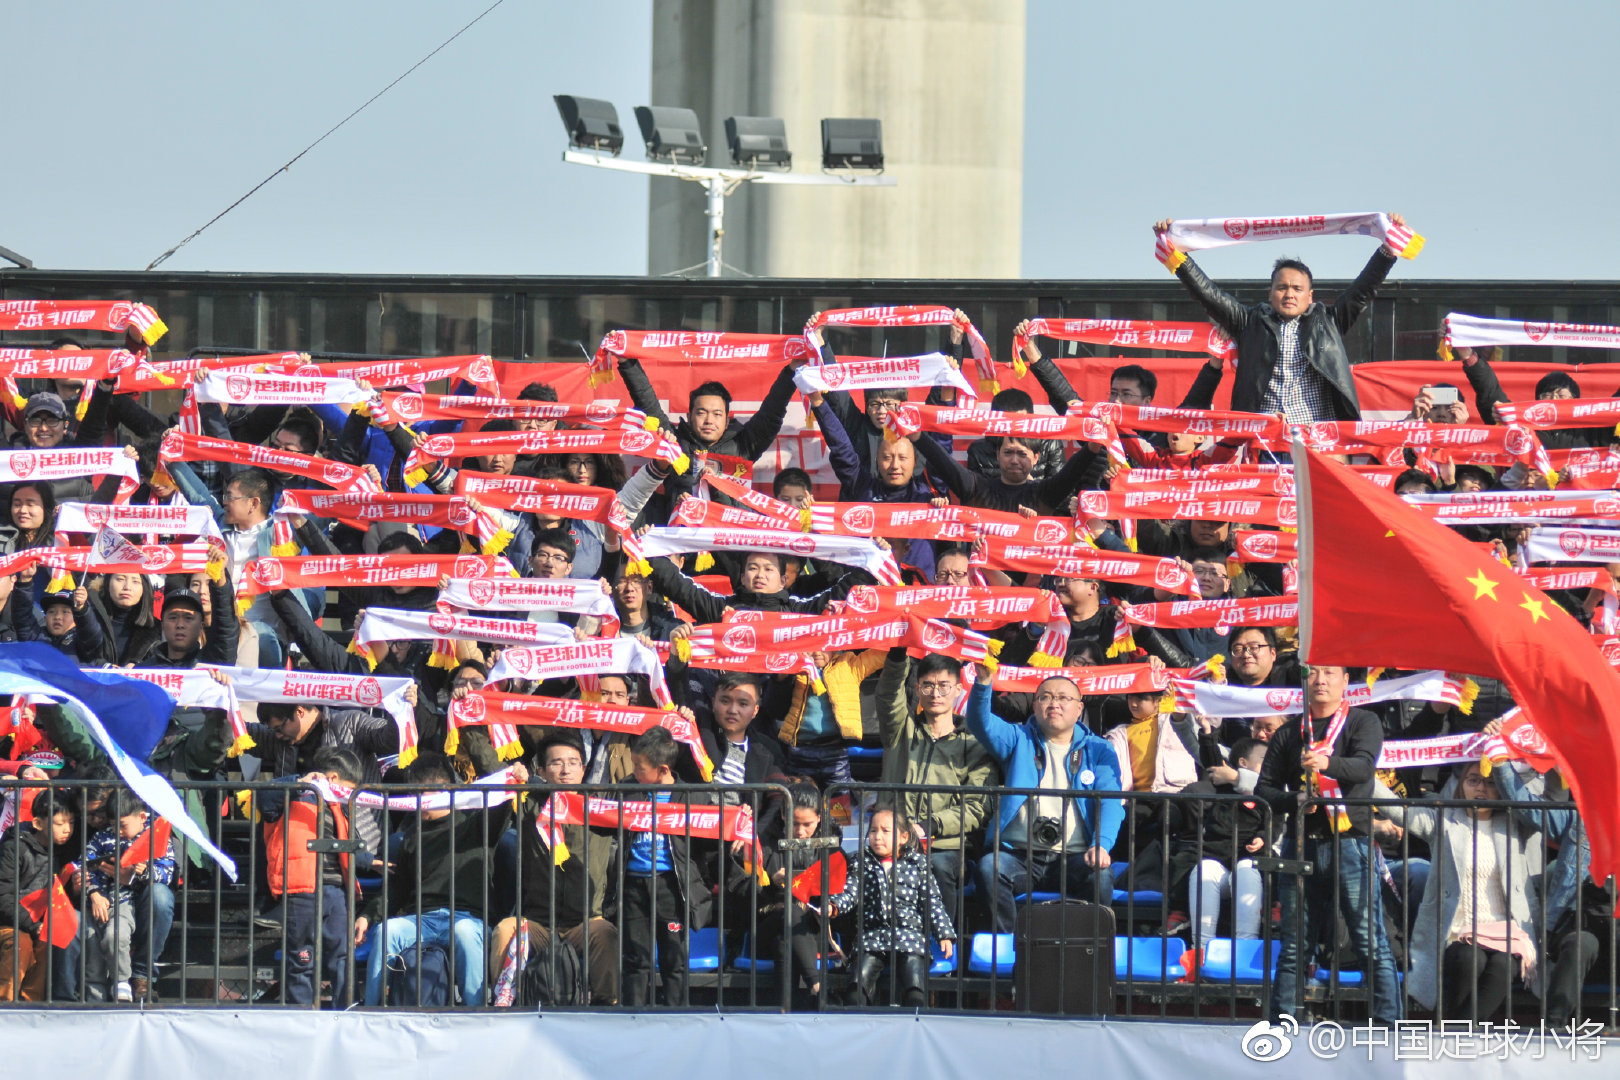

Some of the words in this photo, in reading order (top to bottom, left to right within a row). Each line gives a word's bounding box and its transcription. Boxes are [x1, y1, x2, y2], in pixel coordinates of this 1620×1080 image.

[849, 358, 921, 378] 足球小将
[254, 379, 327, 395] 足球小将
[39, 451, 114, 467] 足球小将
[113, 506, 188, 522] 足球小将
[498, 581, 577, 600] 足球小将
[459, 618, 538, 636] 足球小将
[536, 643, 613, 664] 足球小将
[537, 665, 566, 674] CHINESE
[566, 662, 599, 671] FOOTBALL
[600, 660, 614, 668] BOY
[282, 680, 353, 700] 足球小将
